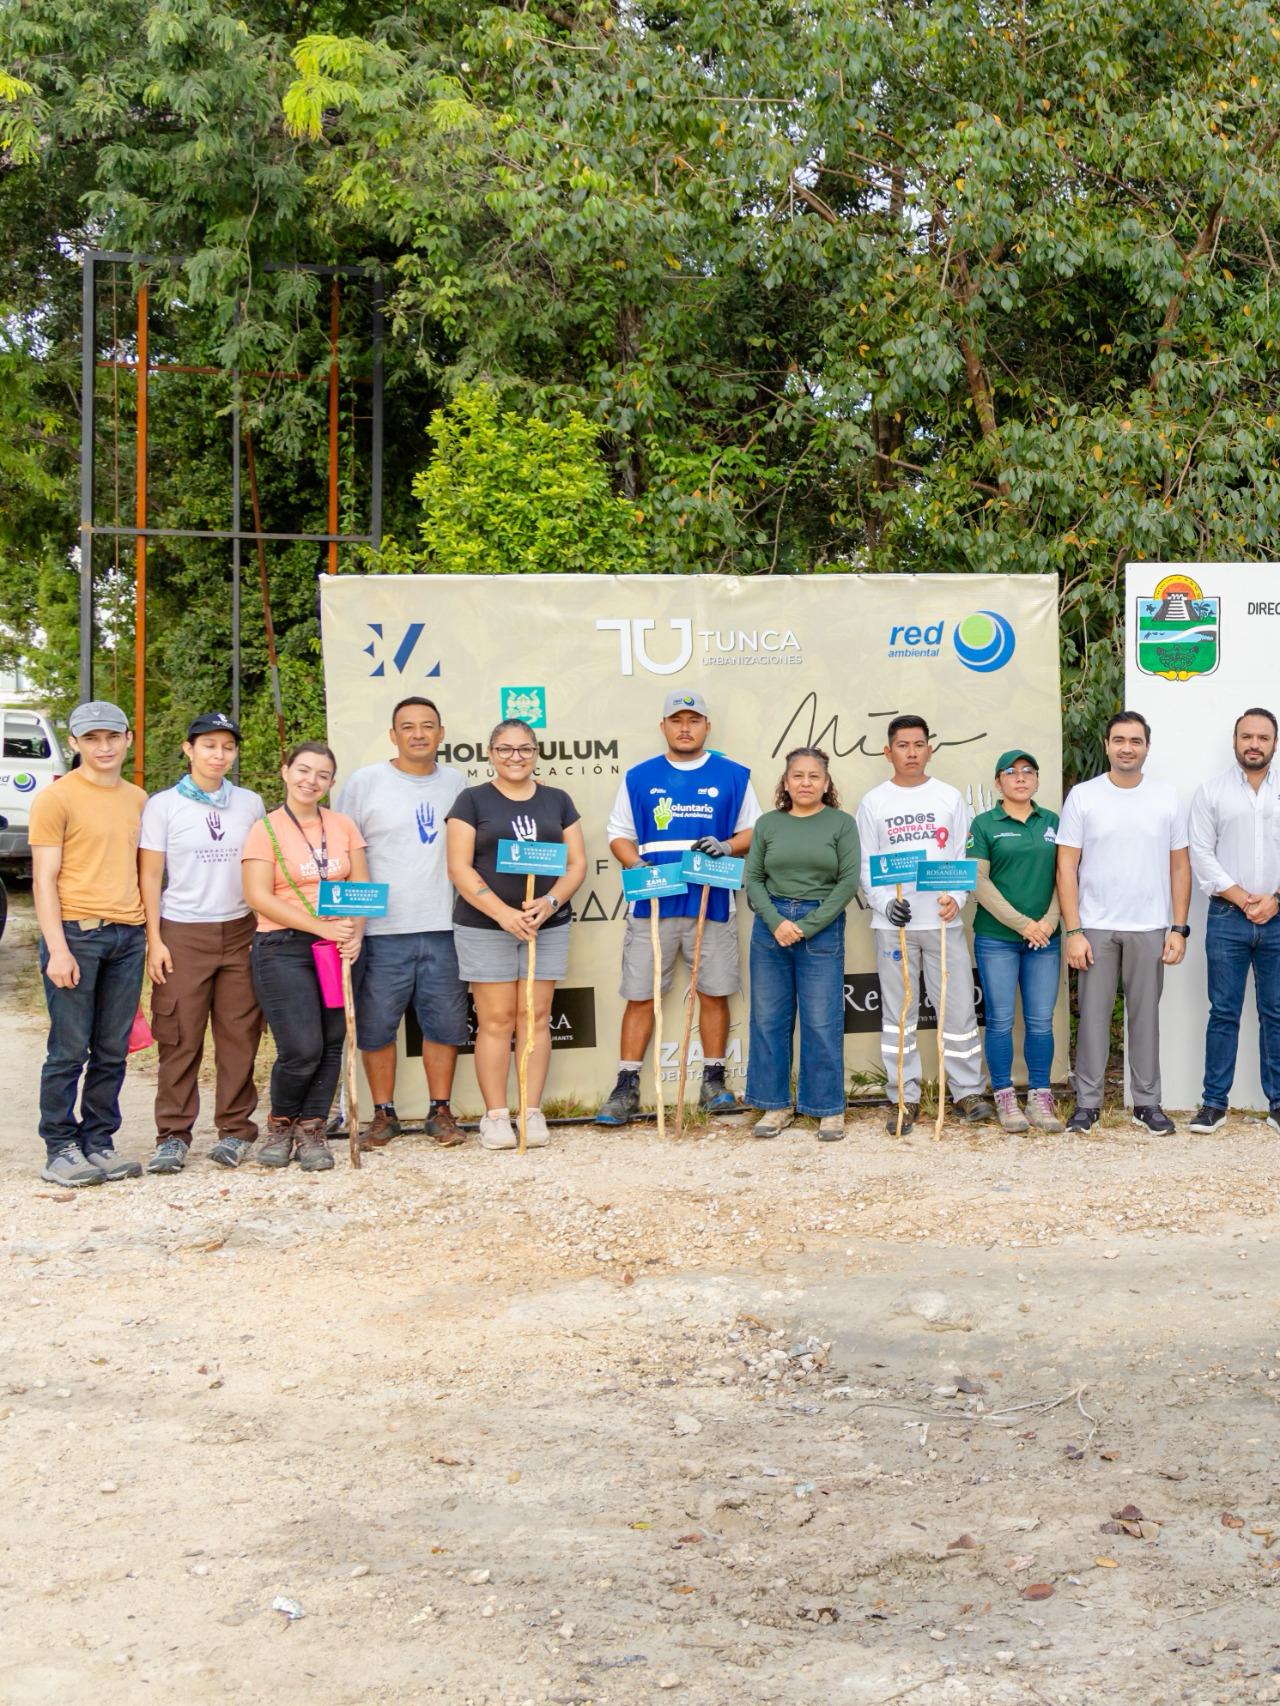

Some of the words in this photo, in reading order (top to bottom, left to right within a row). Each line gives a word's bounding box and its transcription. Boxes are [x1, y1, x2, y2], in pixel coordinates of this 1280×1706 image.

[888, 620, 944, 647] red
[699, 630, 801, 652] TUNCA
[887, 647, 941, 659] ambiental
[701, 655, 803, 667] URBANIZACIONES
[885, 812, 936, 828] TOD@S
[887, 824, 923, 836] CONTRA
[925, 823, 937, 831] EL
